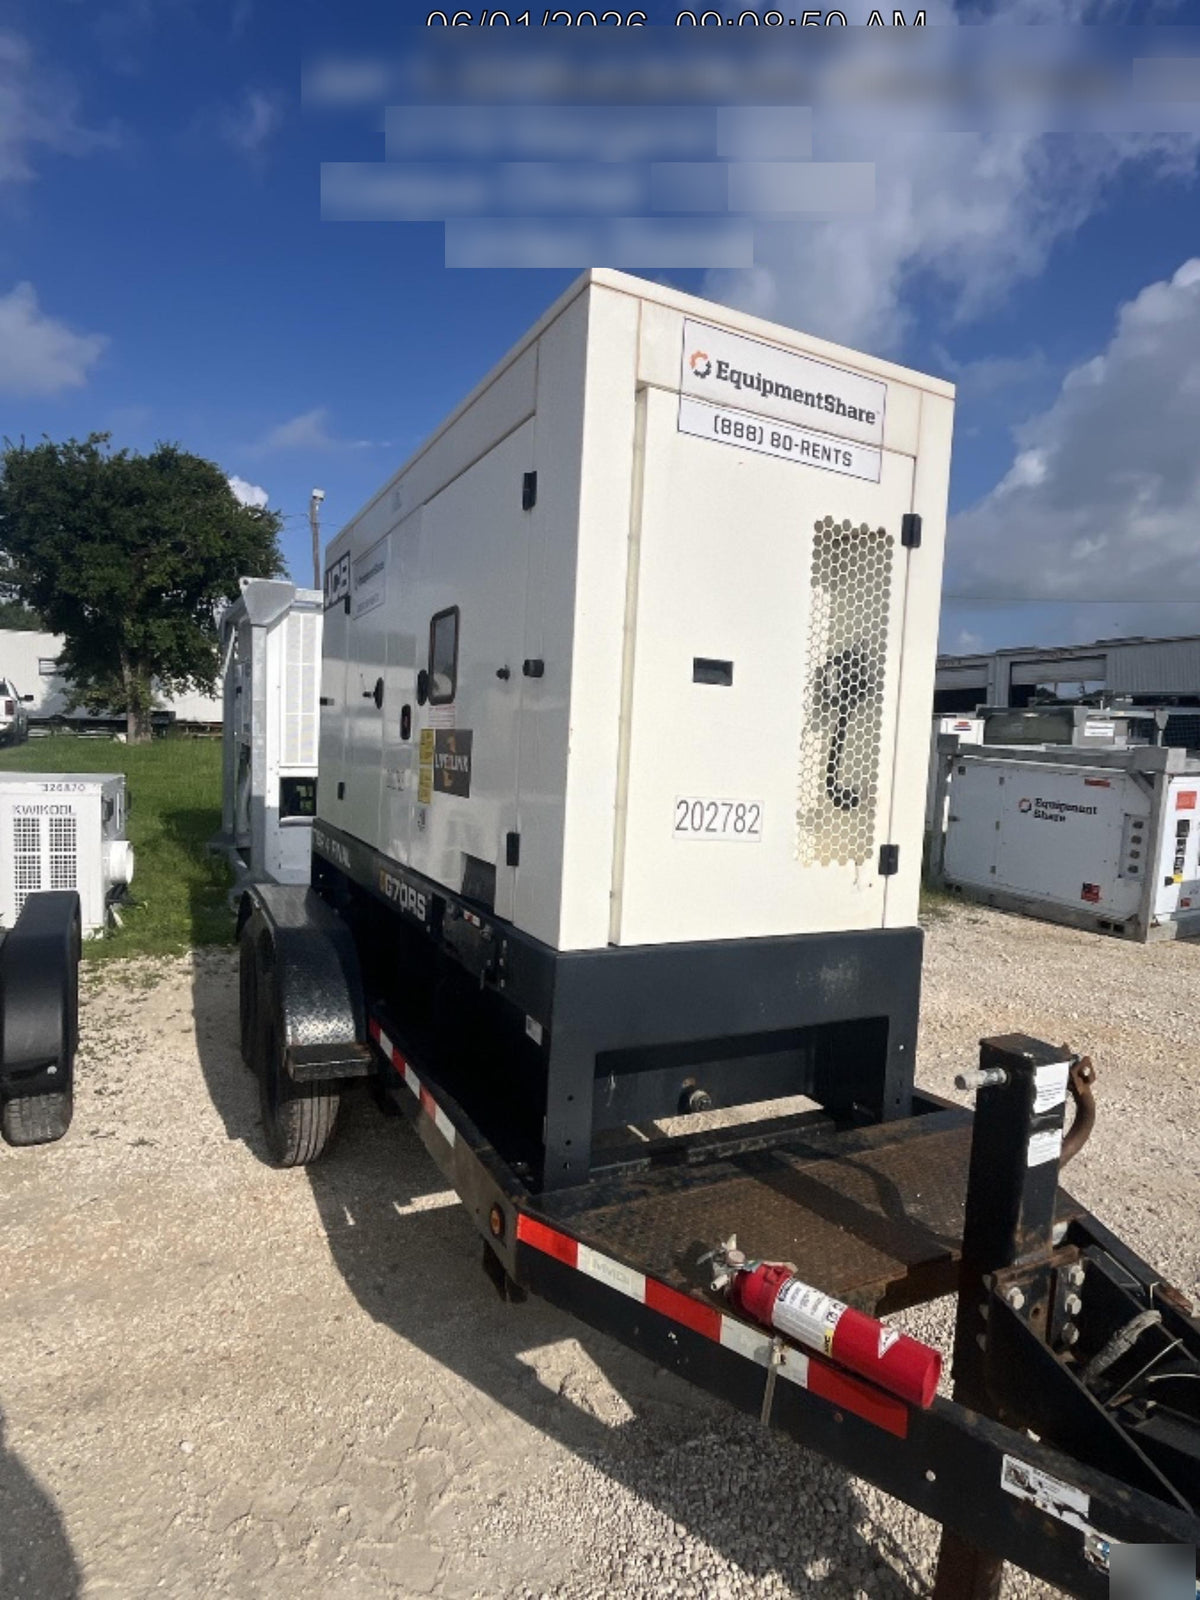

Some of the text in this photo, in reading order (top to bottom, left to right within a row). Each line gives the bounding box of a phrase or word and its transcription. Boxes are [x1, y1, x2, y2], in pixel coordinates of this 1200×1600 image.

[715, 359, 877, 425] EquipmentShare
[713, 414, 764, 445] (888)
[675, 799, 760, 834] 202782
[1034, 797, 1098, 815] Equipment
